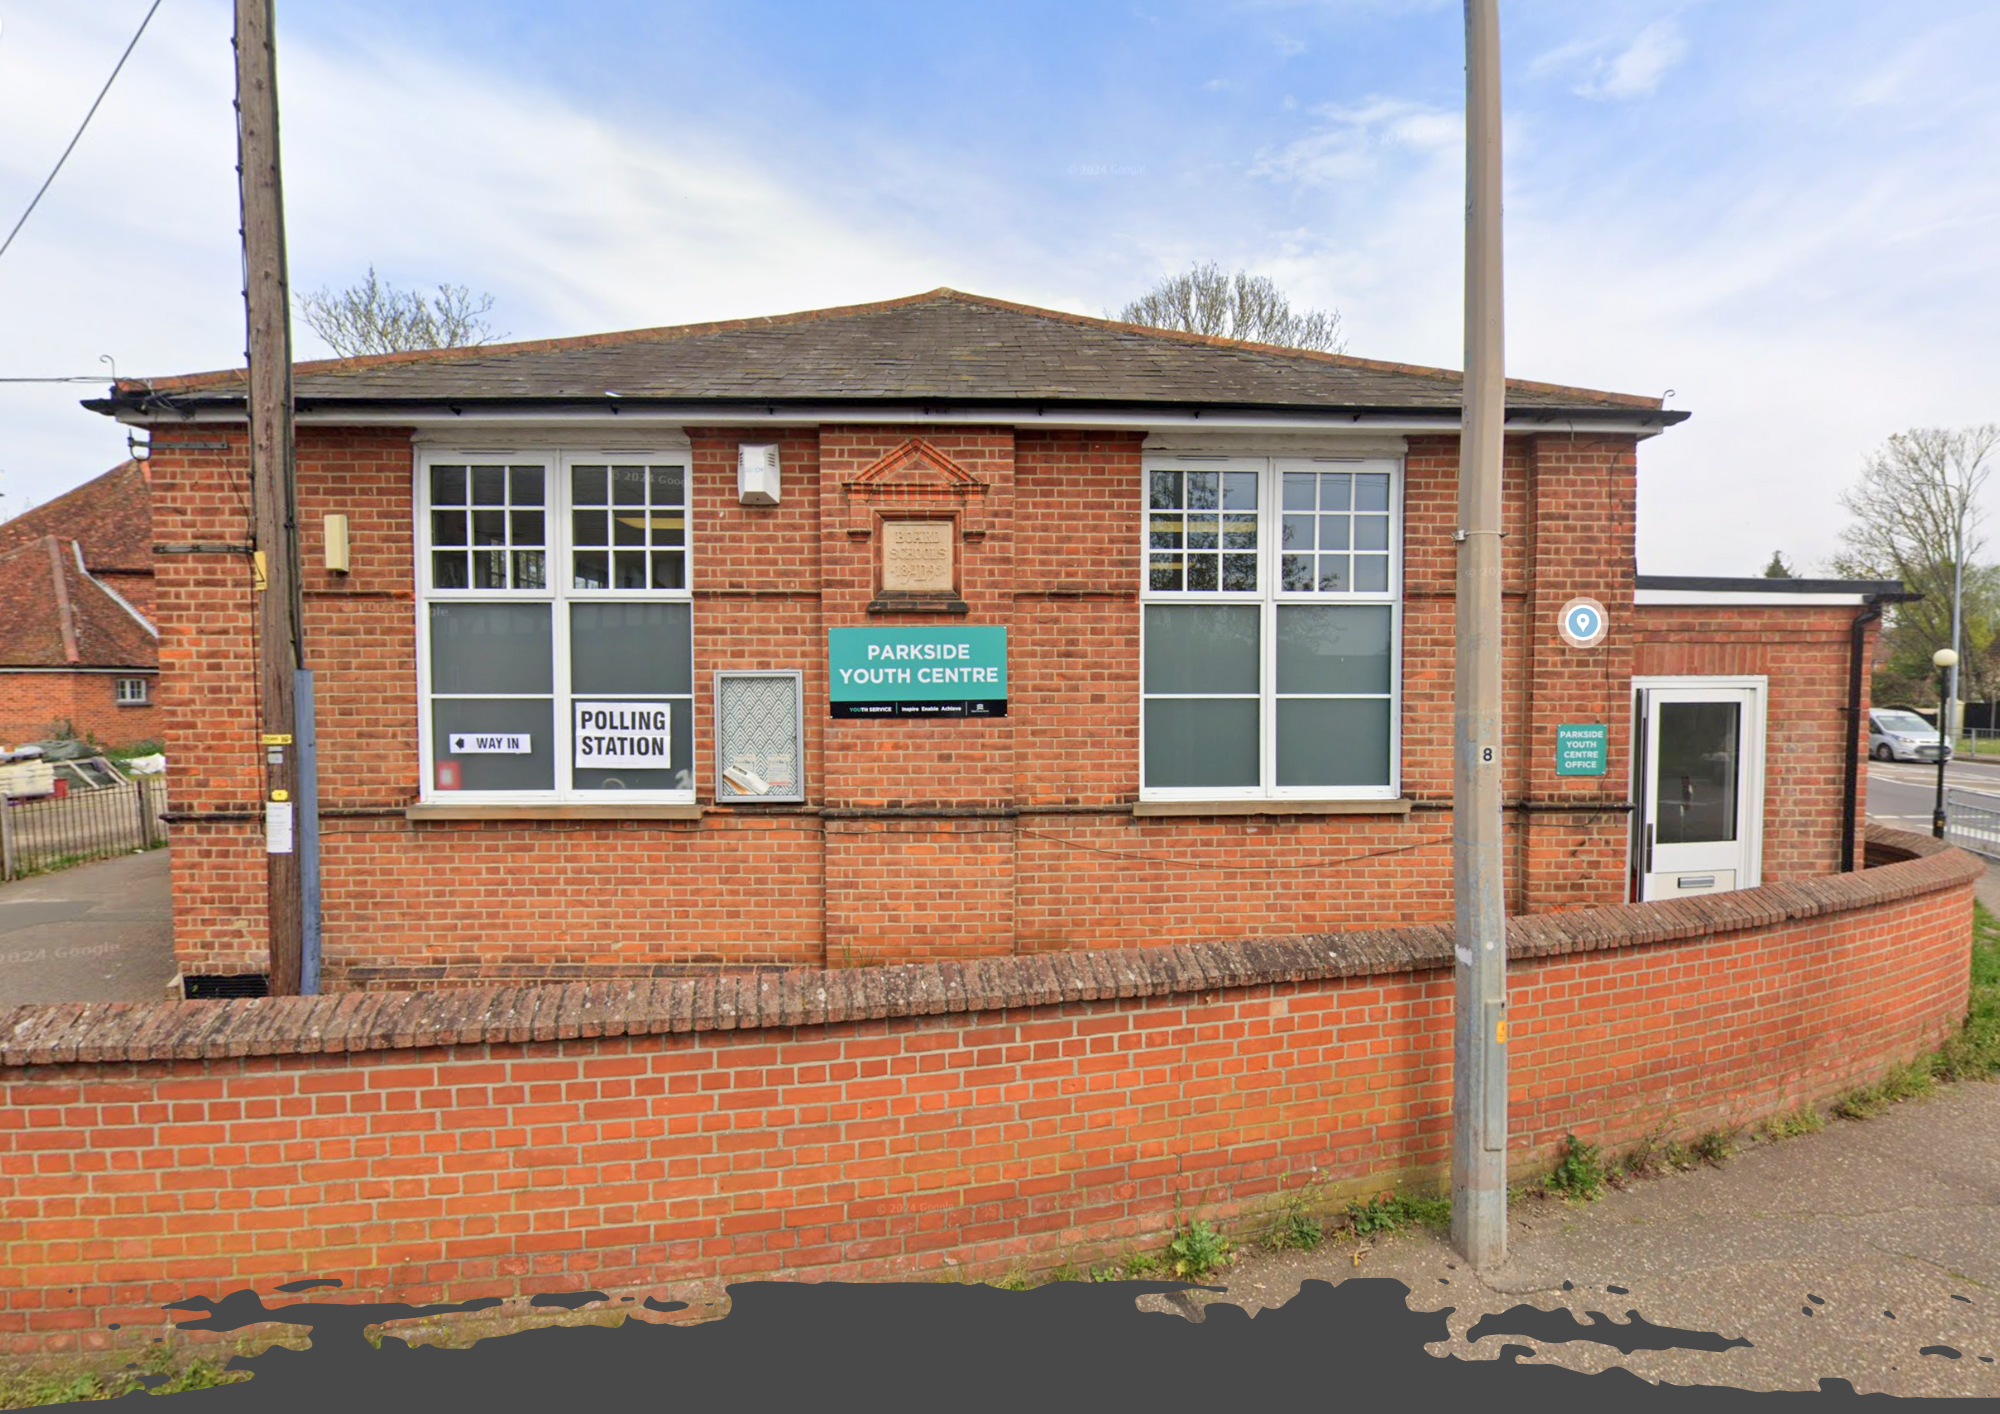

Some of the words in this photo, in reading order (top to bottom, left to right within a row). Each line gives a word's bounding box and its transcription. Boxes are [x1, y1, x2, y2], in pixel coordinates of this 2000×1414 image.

[889, 548, 947, 561] SCHOOLS
[868, 644, 970, 660] PARKSIDE
[839, 668, 911, 684] YOUTH
[917, 667, 999, 683] CENTRE
[581, 710, 666, 731] POLLING
[476, 738, 503, 749] WAY
[507, 737, 519, 749] IN
[581, 736, 664, 756] STATION
[1483, 747, 1492, 762] 8
